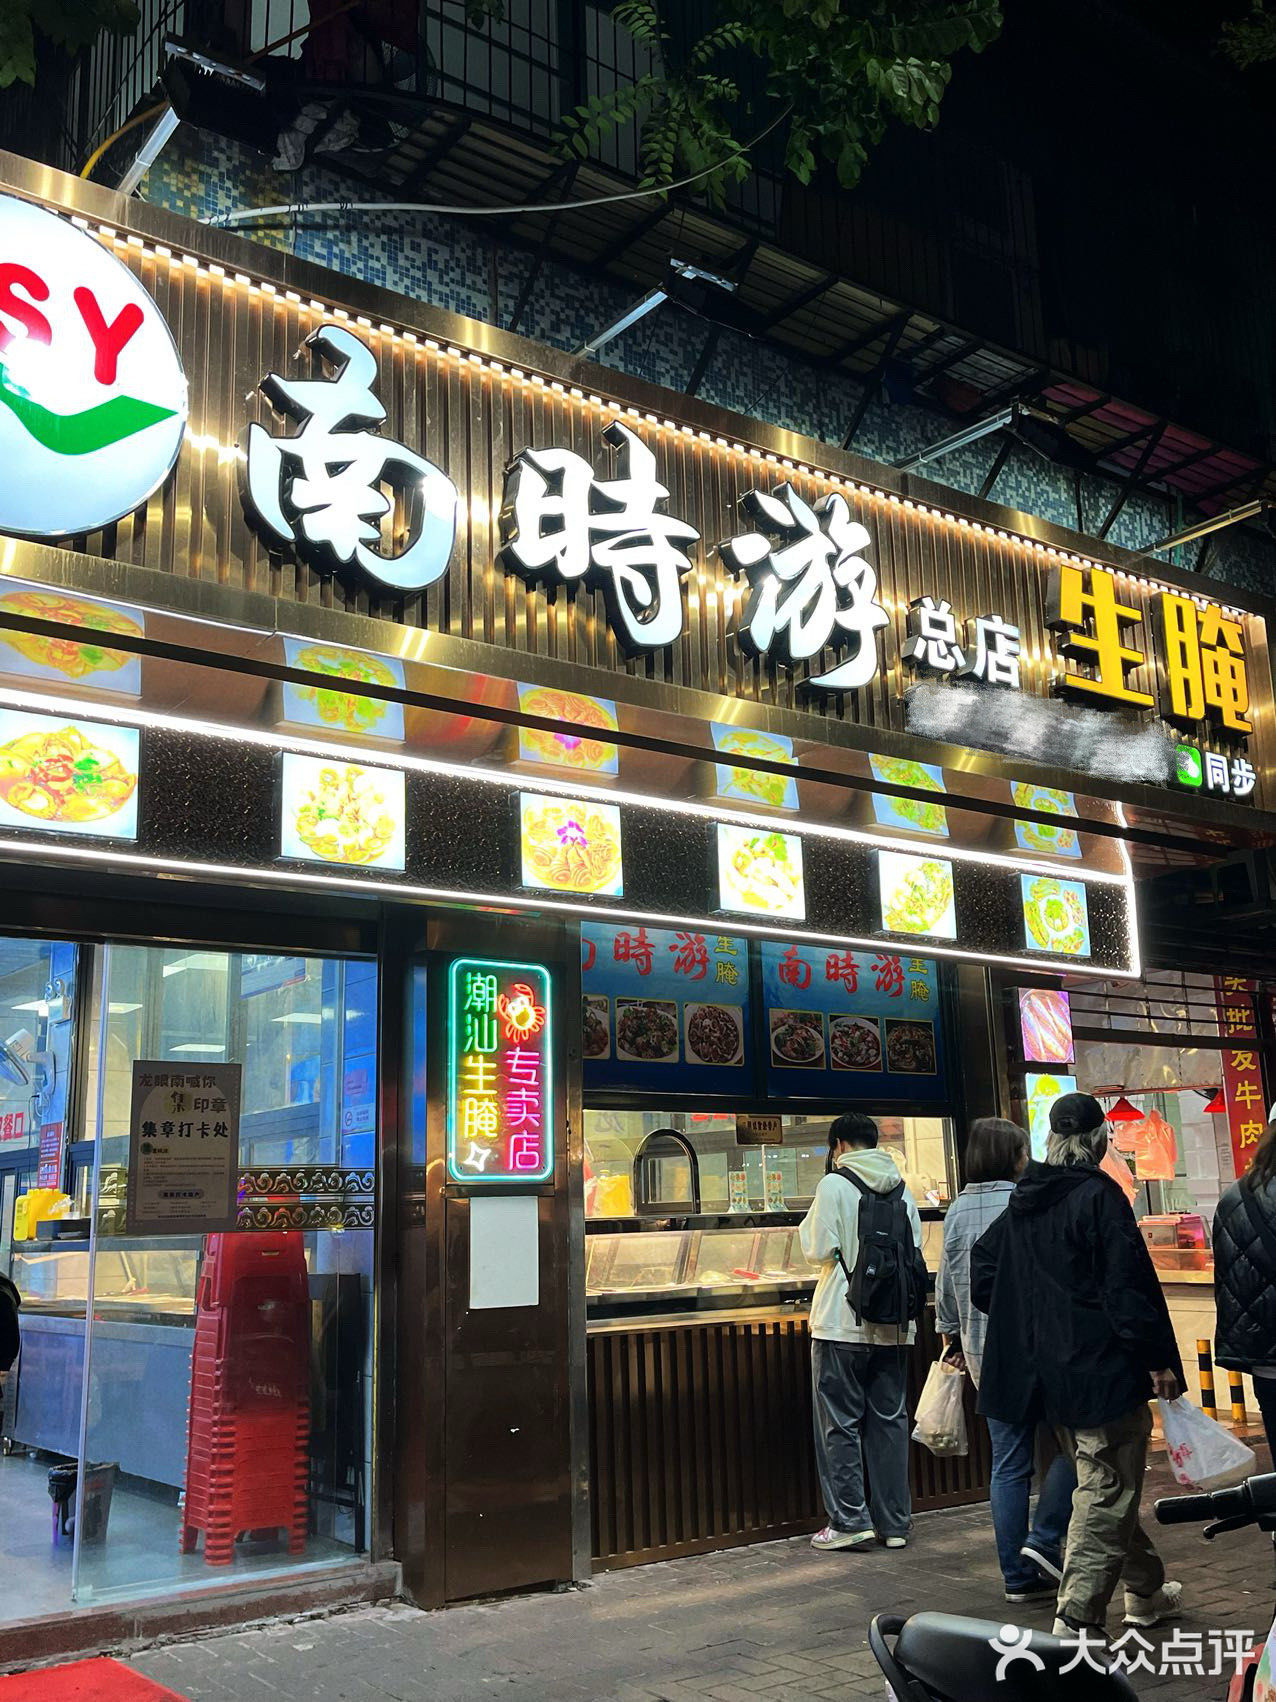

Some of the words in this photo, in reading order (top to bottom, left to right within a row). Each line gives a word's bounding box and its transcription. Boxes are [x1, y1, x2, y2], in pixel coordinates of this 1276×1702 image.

[909, 595, 1021, 689] 总店
[1057, 565, 1253, 735] 生腌
[1204, 751, 1258, 797] 同步
[463, 971, 498, 1139] 潮汕生腌
[506, 1046, 541, 1171] 专卖店
[141, 1121, 229, 1139] 集章打卡处
